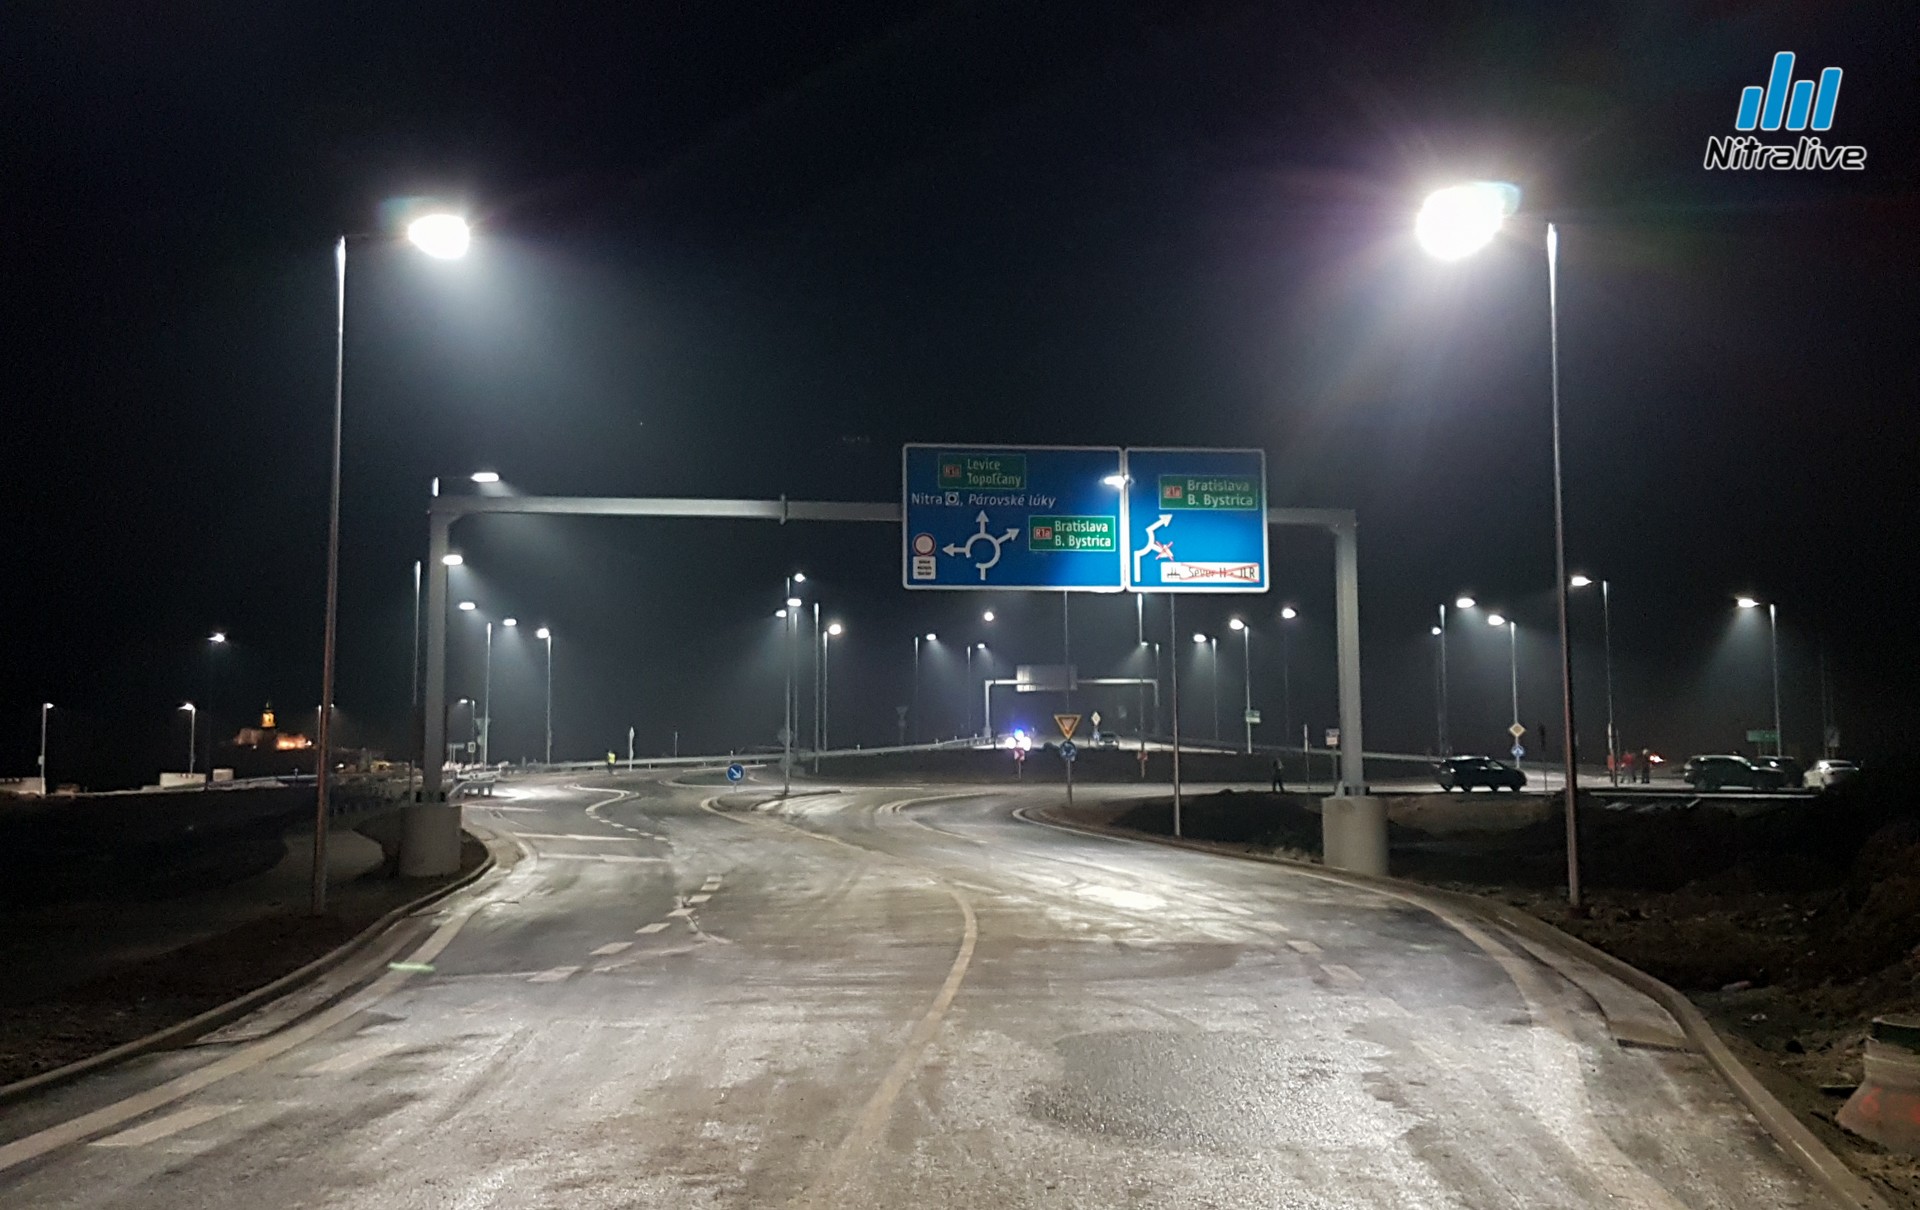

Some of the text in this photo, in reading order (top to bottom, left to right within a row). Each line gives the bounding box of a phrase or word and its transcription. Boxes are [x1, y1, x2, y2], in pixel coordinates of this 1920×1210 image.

[967, 459, 1000, 470] Levice
[1187, 479, 1250, 492] Bratislava
[911, 492, 943, 505] Nitra
[968, 493, 1056, 508] Párovské lúky
[1187, 493, 1254, 508] B. Bystrica
[1055, 520, 1109, 533] Bratislava
[1055, 534, 1112, 549] B. Bystrica
